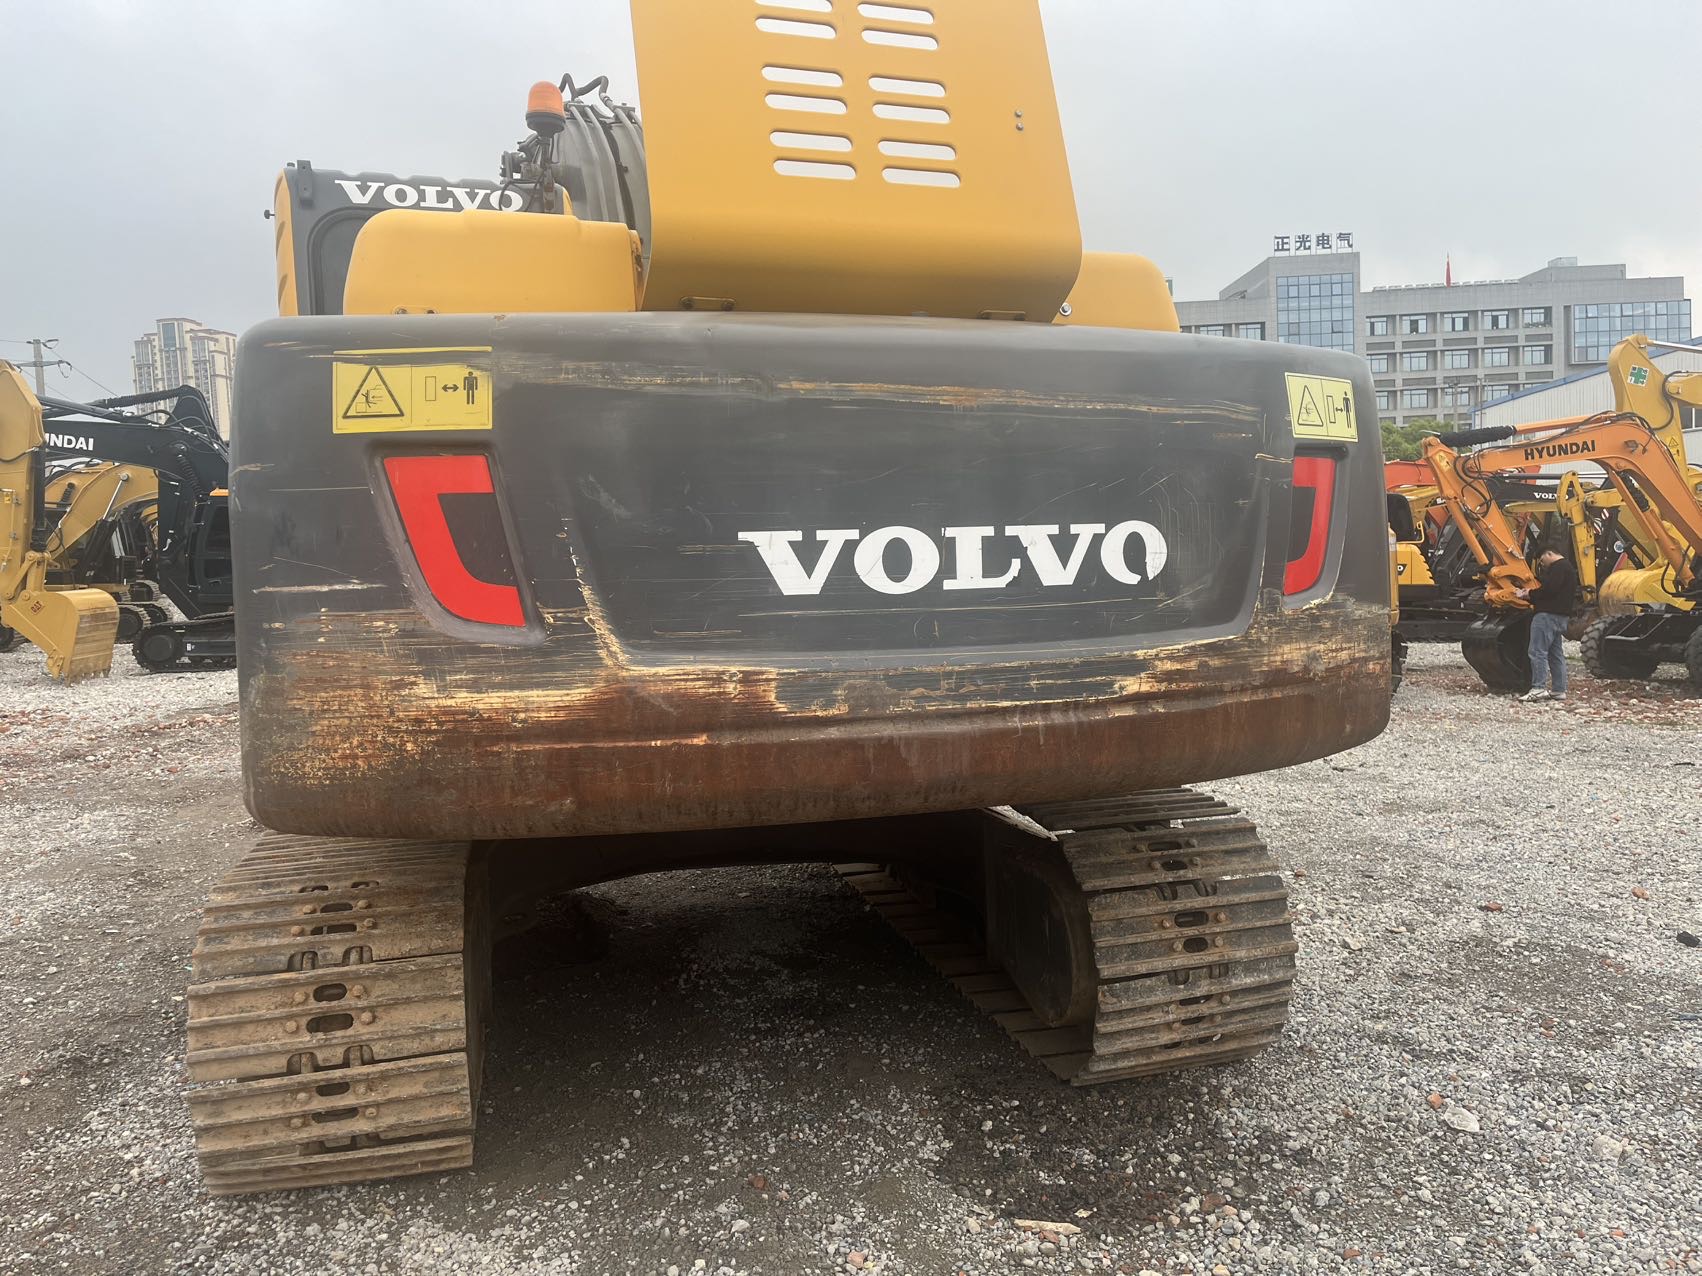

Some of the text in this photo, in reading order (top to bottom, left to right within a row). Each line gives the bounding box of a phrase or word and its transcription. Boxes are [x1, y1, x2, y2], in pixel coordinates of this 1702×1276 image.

[335, 180, 523, 212] VOLVO
[1274, 232, 1353, 251] 正光电气
[1524, 440, 1596, 460] HYUNDAI
[738, 520, 1168, 595] VOLVO
